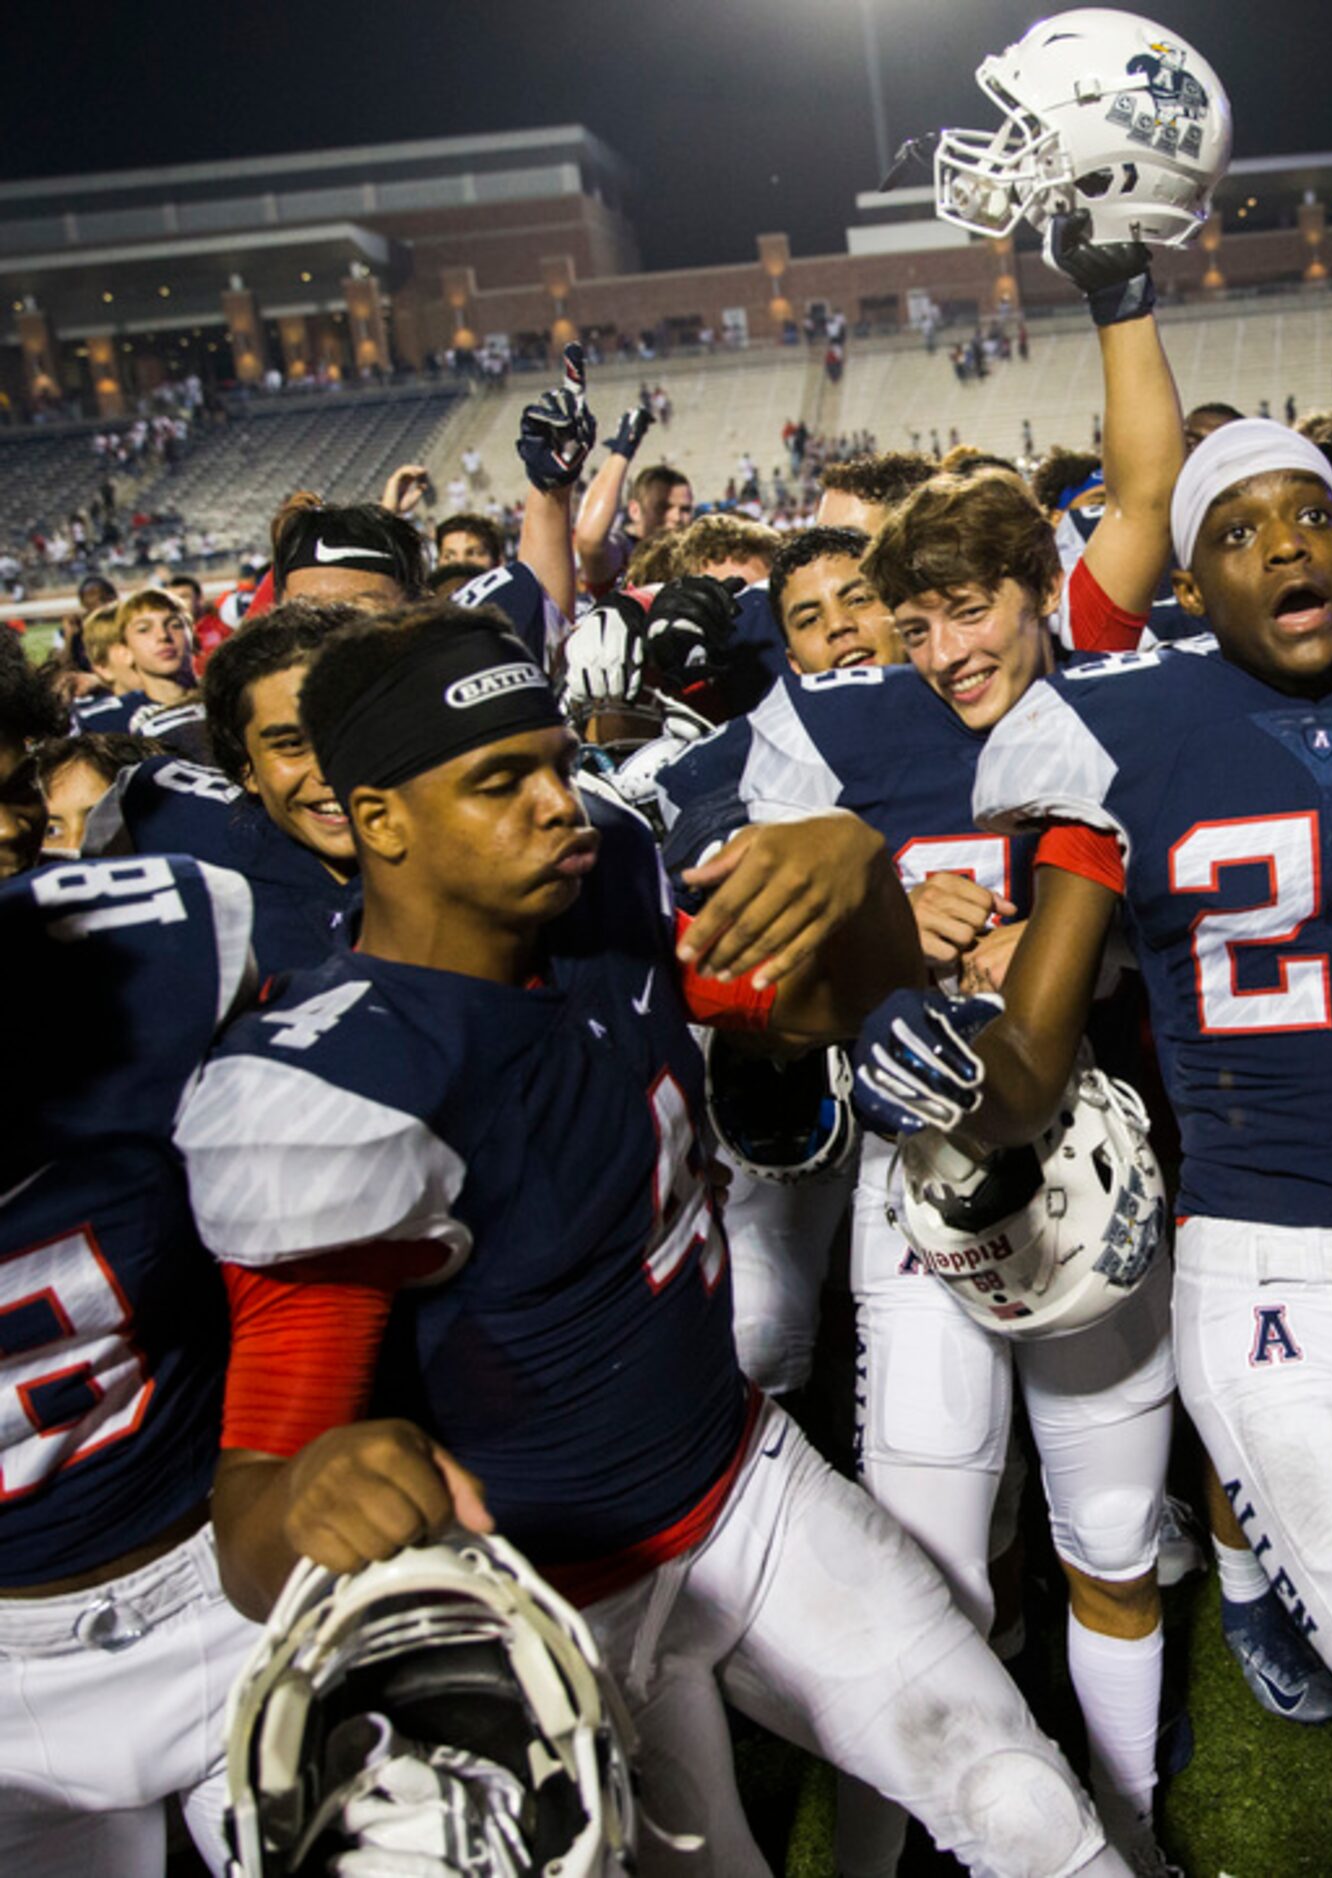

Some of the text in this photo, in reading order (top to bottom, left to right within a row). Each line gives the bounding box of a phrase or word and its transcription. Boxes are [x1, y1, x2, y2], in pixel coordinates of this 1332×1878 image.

[460, 666, 545, 704] BATTL
[261, 979, 374, 1050] 4
[640, 1063, 726, 1295] 4
[1249, 1304, 1303, 1368] A
